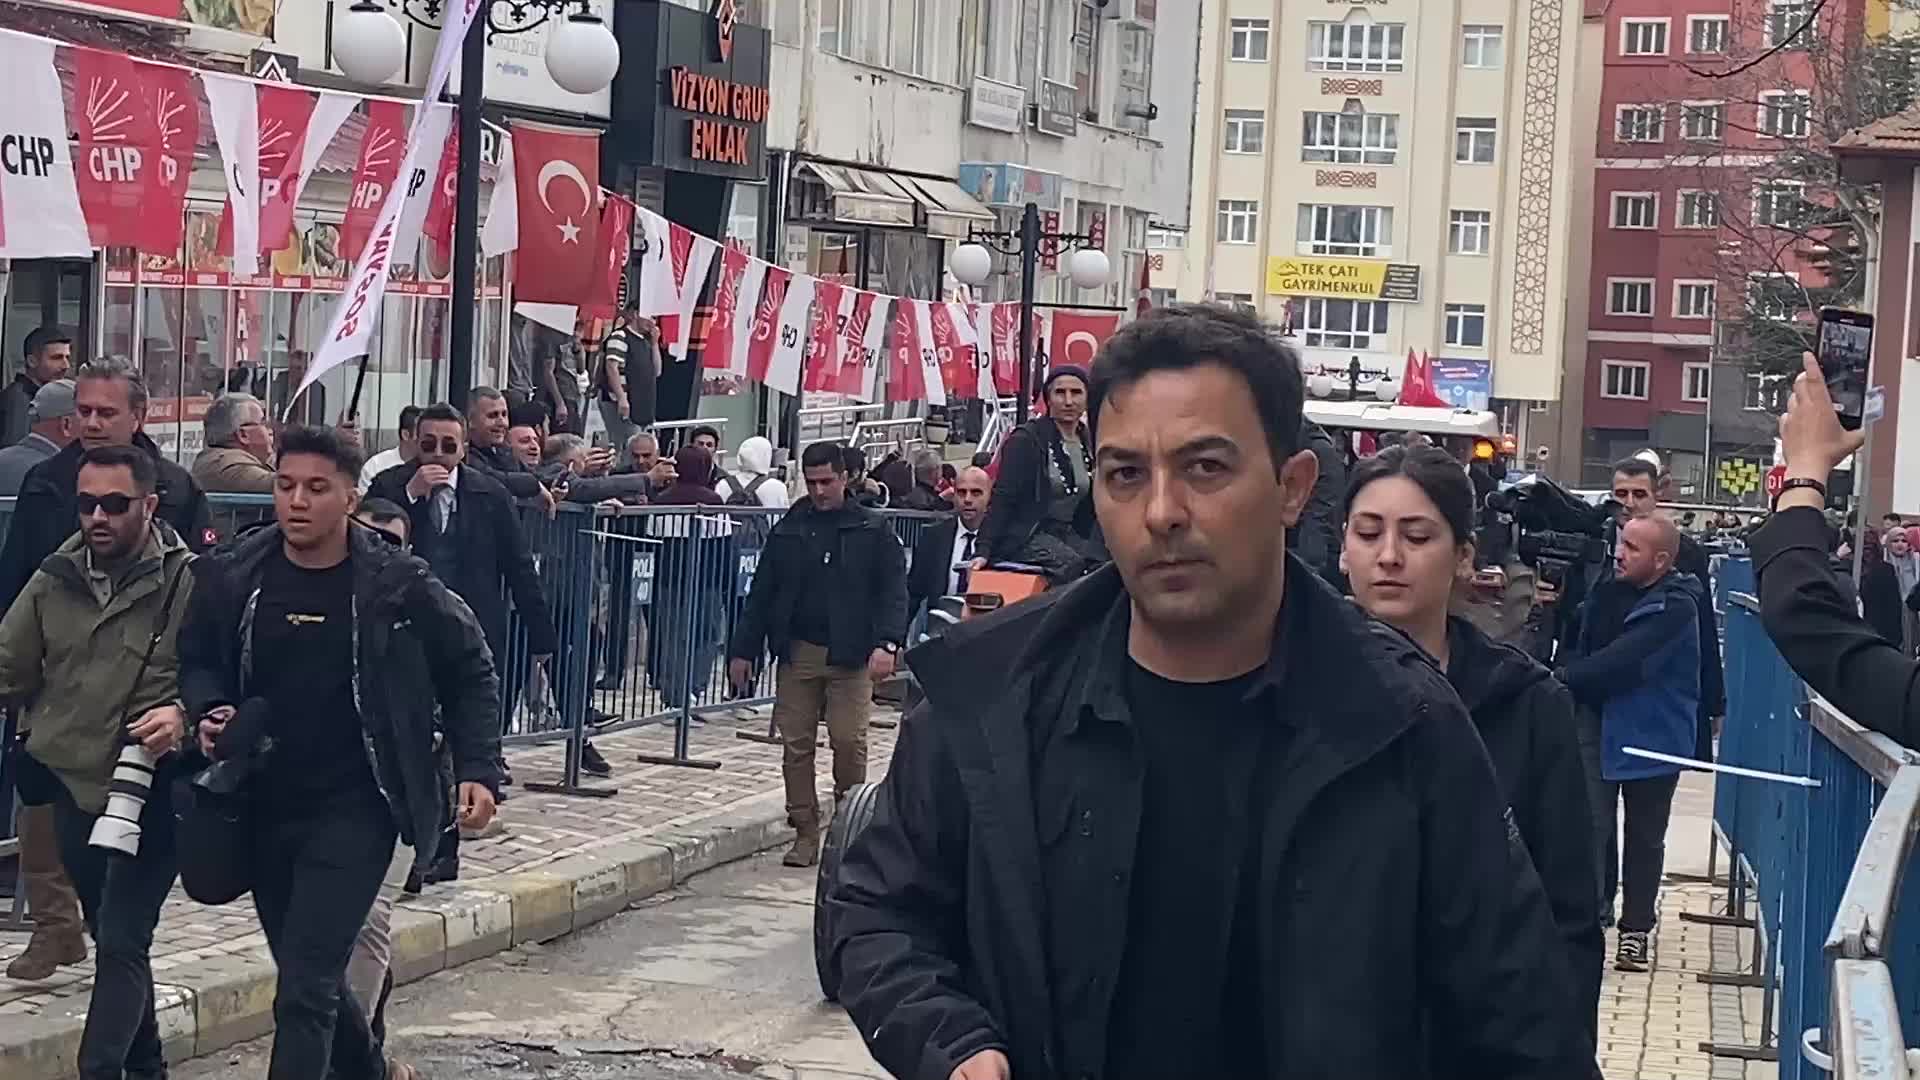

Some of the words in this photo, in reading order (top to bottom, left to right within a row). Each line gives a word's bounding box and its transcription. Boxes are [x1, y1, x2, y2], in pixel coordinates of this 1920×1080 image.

[671, 65, 730, 116] VİZYON
[1, 134, 54, 177] CHP
[691, 119, 749, 166] EMLAK
[89, 147, 142, 182] CHP
[1282, 278, 1375, 294] GAYRİMENKUL
[1301, 263, 1324, 276] TEK
[1329, 264, 1359, 279] ÇATI
